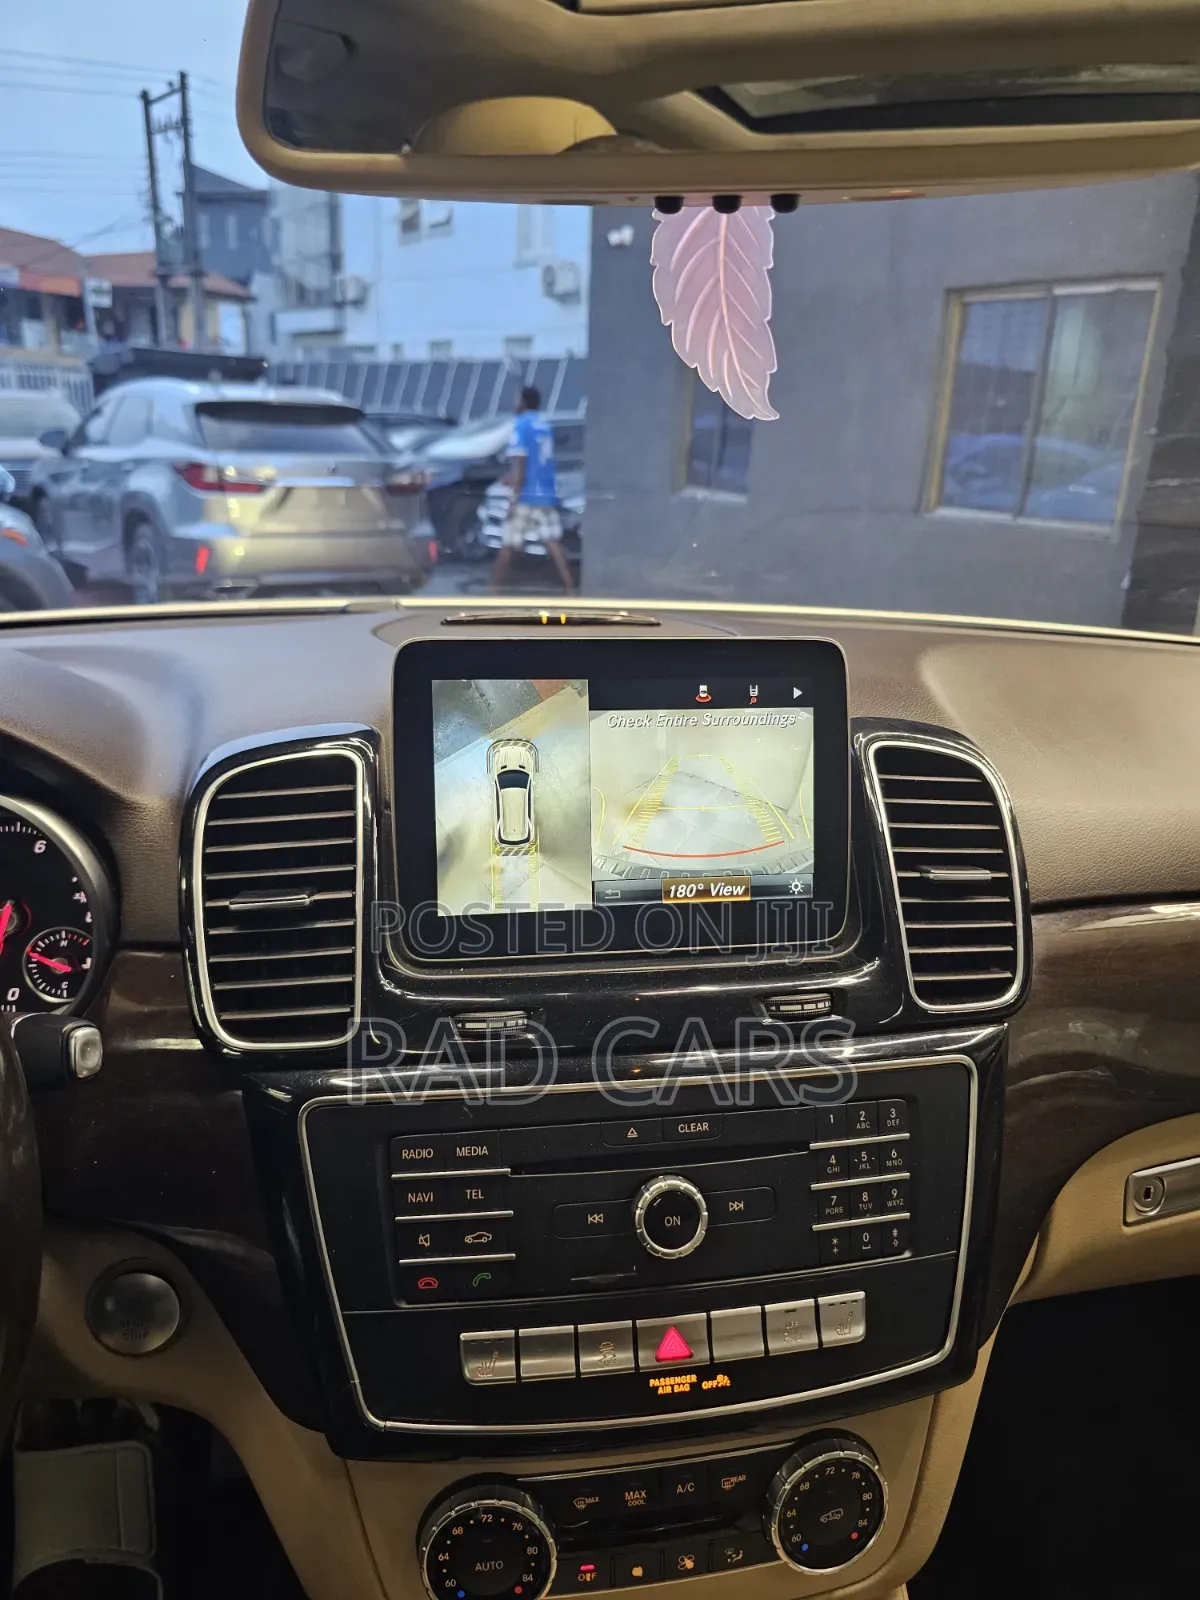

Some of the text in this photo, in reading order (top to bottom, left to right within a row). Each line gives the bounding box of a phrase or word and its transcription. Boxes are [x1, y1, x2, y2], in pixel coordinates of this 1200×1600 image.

[607, 712, 797, 729] Check Entire Surroundings
[34, 839, 47, 853] 6
[710, 882, 745, 897] View
[7, 987, 20, 1001] 0
[859, 1110, 866, 1121] 2
[889, 1107, 897, 1118] 3
[829, 1113, 834, 1124] 1
[886, 1119, 900, 1127] DEF
[678, 1122, 709, 1133] CLEAR
[856, 1121, 871, 1129] ABC
[402, 1148, 434, 1159] RADIO
[456, 1146, 489, 1157] MEDIA
[861, 1151, 868, 1161] 5
[891, 1148, 898, 1158] 6
[829, 1154, 837, 1165] 4
[886, 1159, 903, 1167] MNO
[826, 1165, 840, 1174] GHI
[859, 1162, 871, 1170] JKL
[408, 1191, 434, 1203] NAVI
[465, 1188, 485, 1200] TEL
[862, 1191, 869, 1202] 8
[891, 1188, 898, 1198] 9
[830, 1195, 837, 1206] 7
[886, 1198, 904, 1207] WXYZ
[825, 1206, 844, 1215] PQRS
[858, 1202, 873, 1210] TUV
[664, 1216, 681, 1227] ON
[862, 1232, 870, 1242] 0
[650, 1374, 697, 1387] PASSENGER
[702, 1379, 718, 1389] OFF
[657, 1383, 690, 1395] AIR BAG
[825, 1466, 836, 1476] 72
[851, 1471, 861, 1480] 76
[730, 1474, 747, 1483] REAR
[676, 1482, 695, 1494] A/C
[800, 1482, 810, 1491] 68
[585, 1496, 600, 1504] MAX
[625, 1490, 647, 1501] MAX
[862, 1492, 873, 1501] 80
[627, 1499, 647, 1507] COOL
[786, 1508, 797, 1518] 64
[481, 1514, 493, 1523] 72
[857, 1518, 868, 1528] 84
[452, 1526, 464, 1536] 68
[512, 1522, 523, 1532] 76
[791, 1533, 802, 1543] 60
[526, 1547, 538, 1555] 80
[438, 1552, 450, 1561] 64
[475, 1560, 504, 1571] AUTO
[522, 1573, 533, 1582] 84
[445, 1578, 457, 1588] 60
